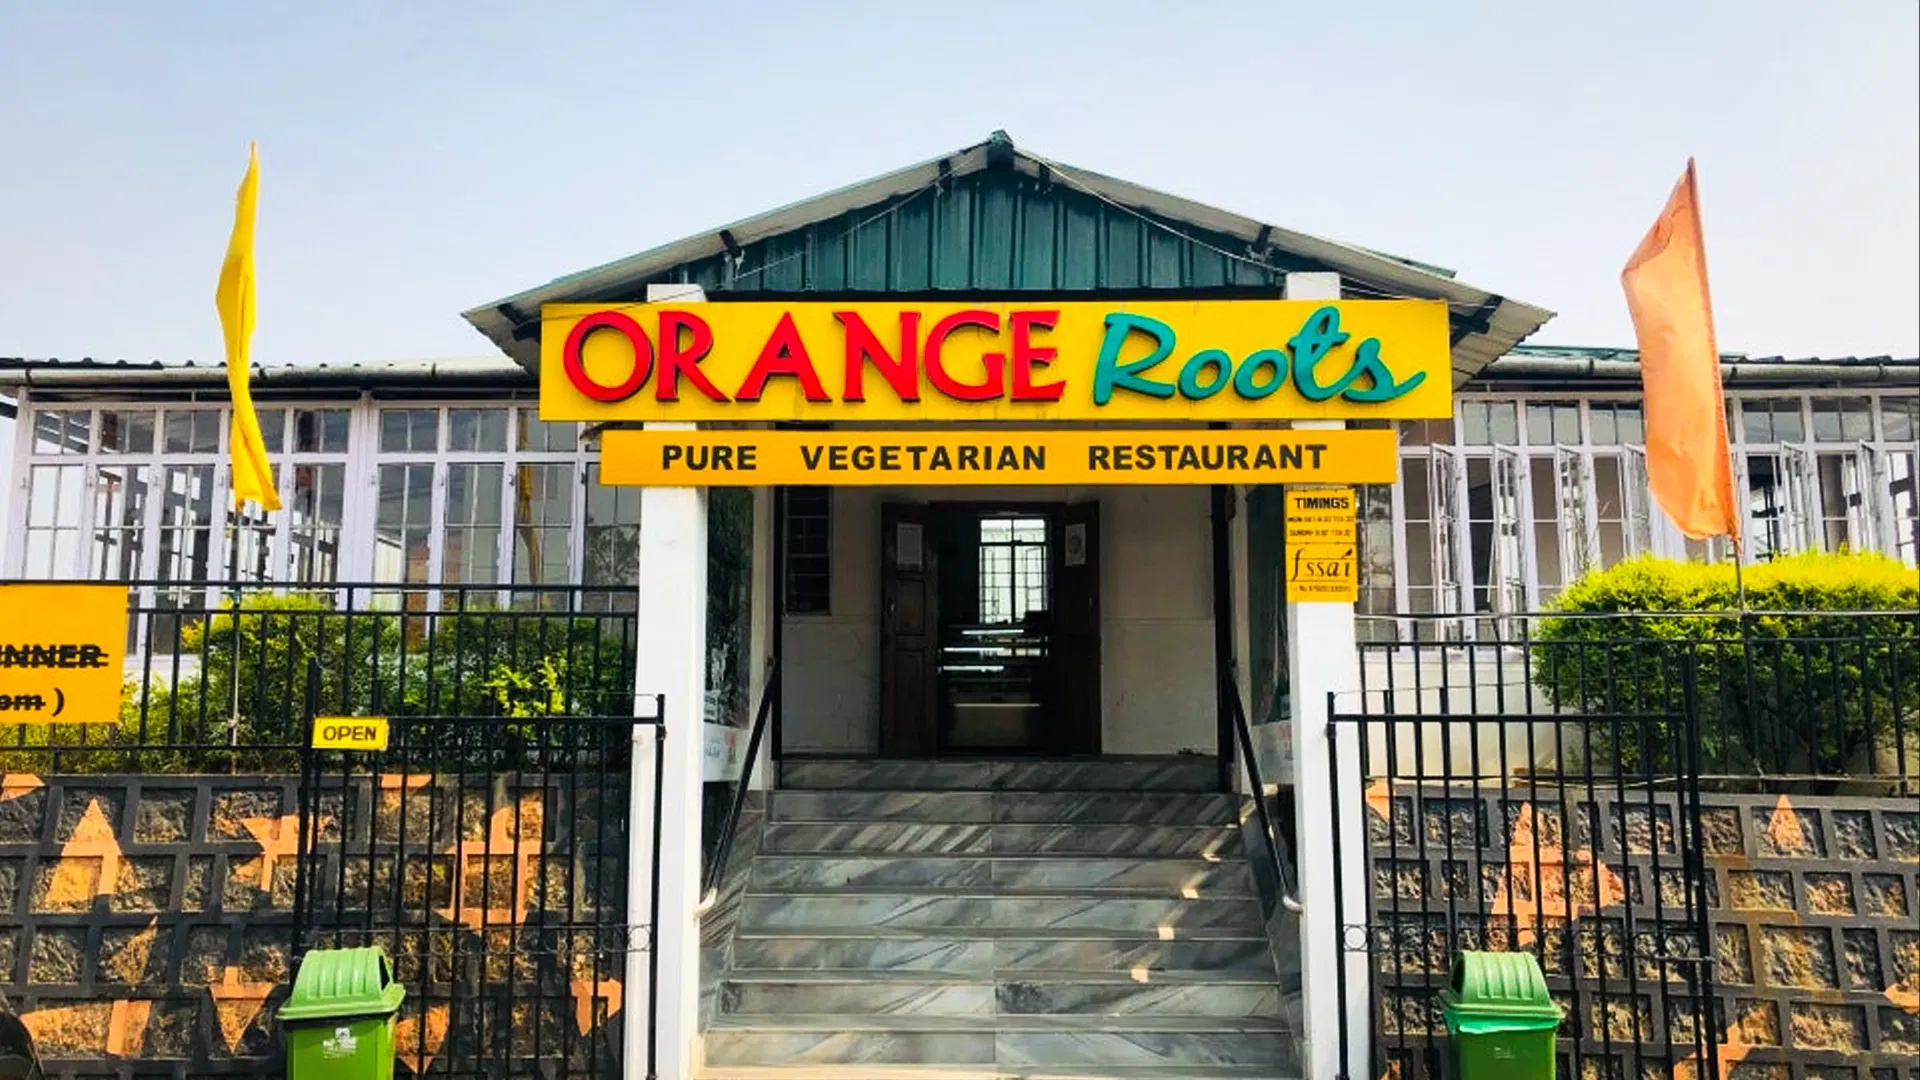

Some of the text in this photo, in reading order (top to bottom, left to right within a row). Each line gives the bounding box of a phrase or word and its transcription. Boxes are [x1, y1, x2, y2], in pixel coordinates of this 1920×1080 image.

[563, 305, 1427, 406] ORANGE Roots
[662, 444, 1328, 471] PURE VEGETARIAN RESTAURANT
[1294, 496, 1349, 509] TIMINGS
[1291, 548, 1353, 582] fssai
[0, 644, 104, 668] NNER
[322, 725, 377, 742] OPEN
